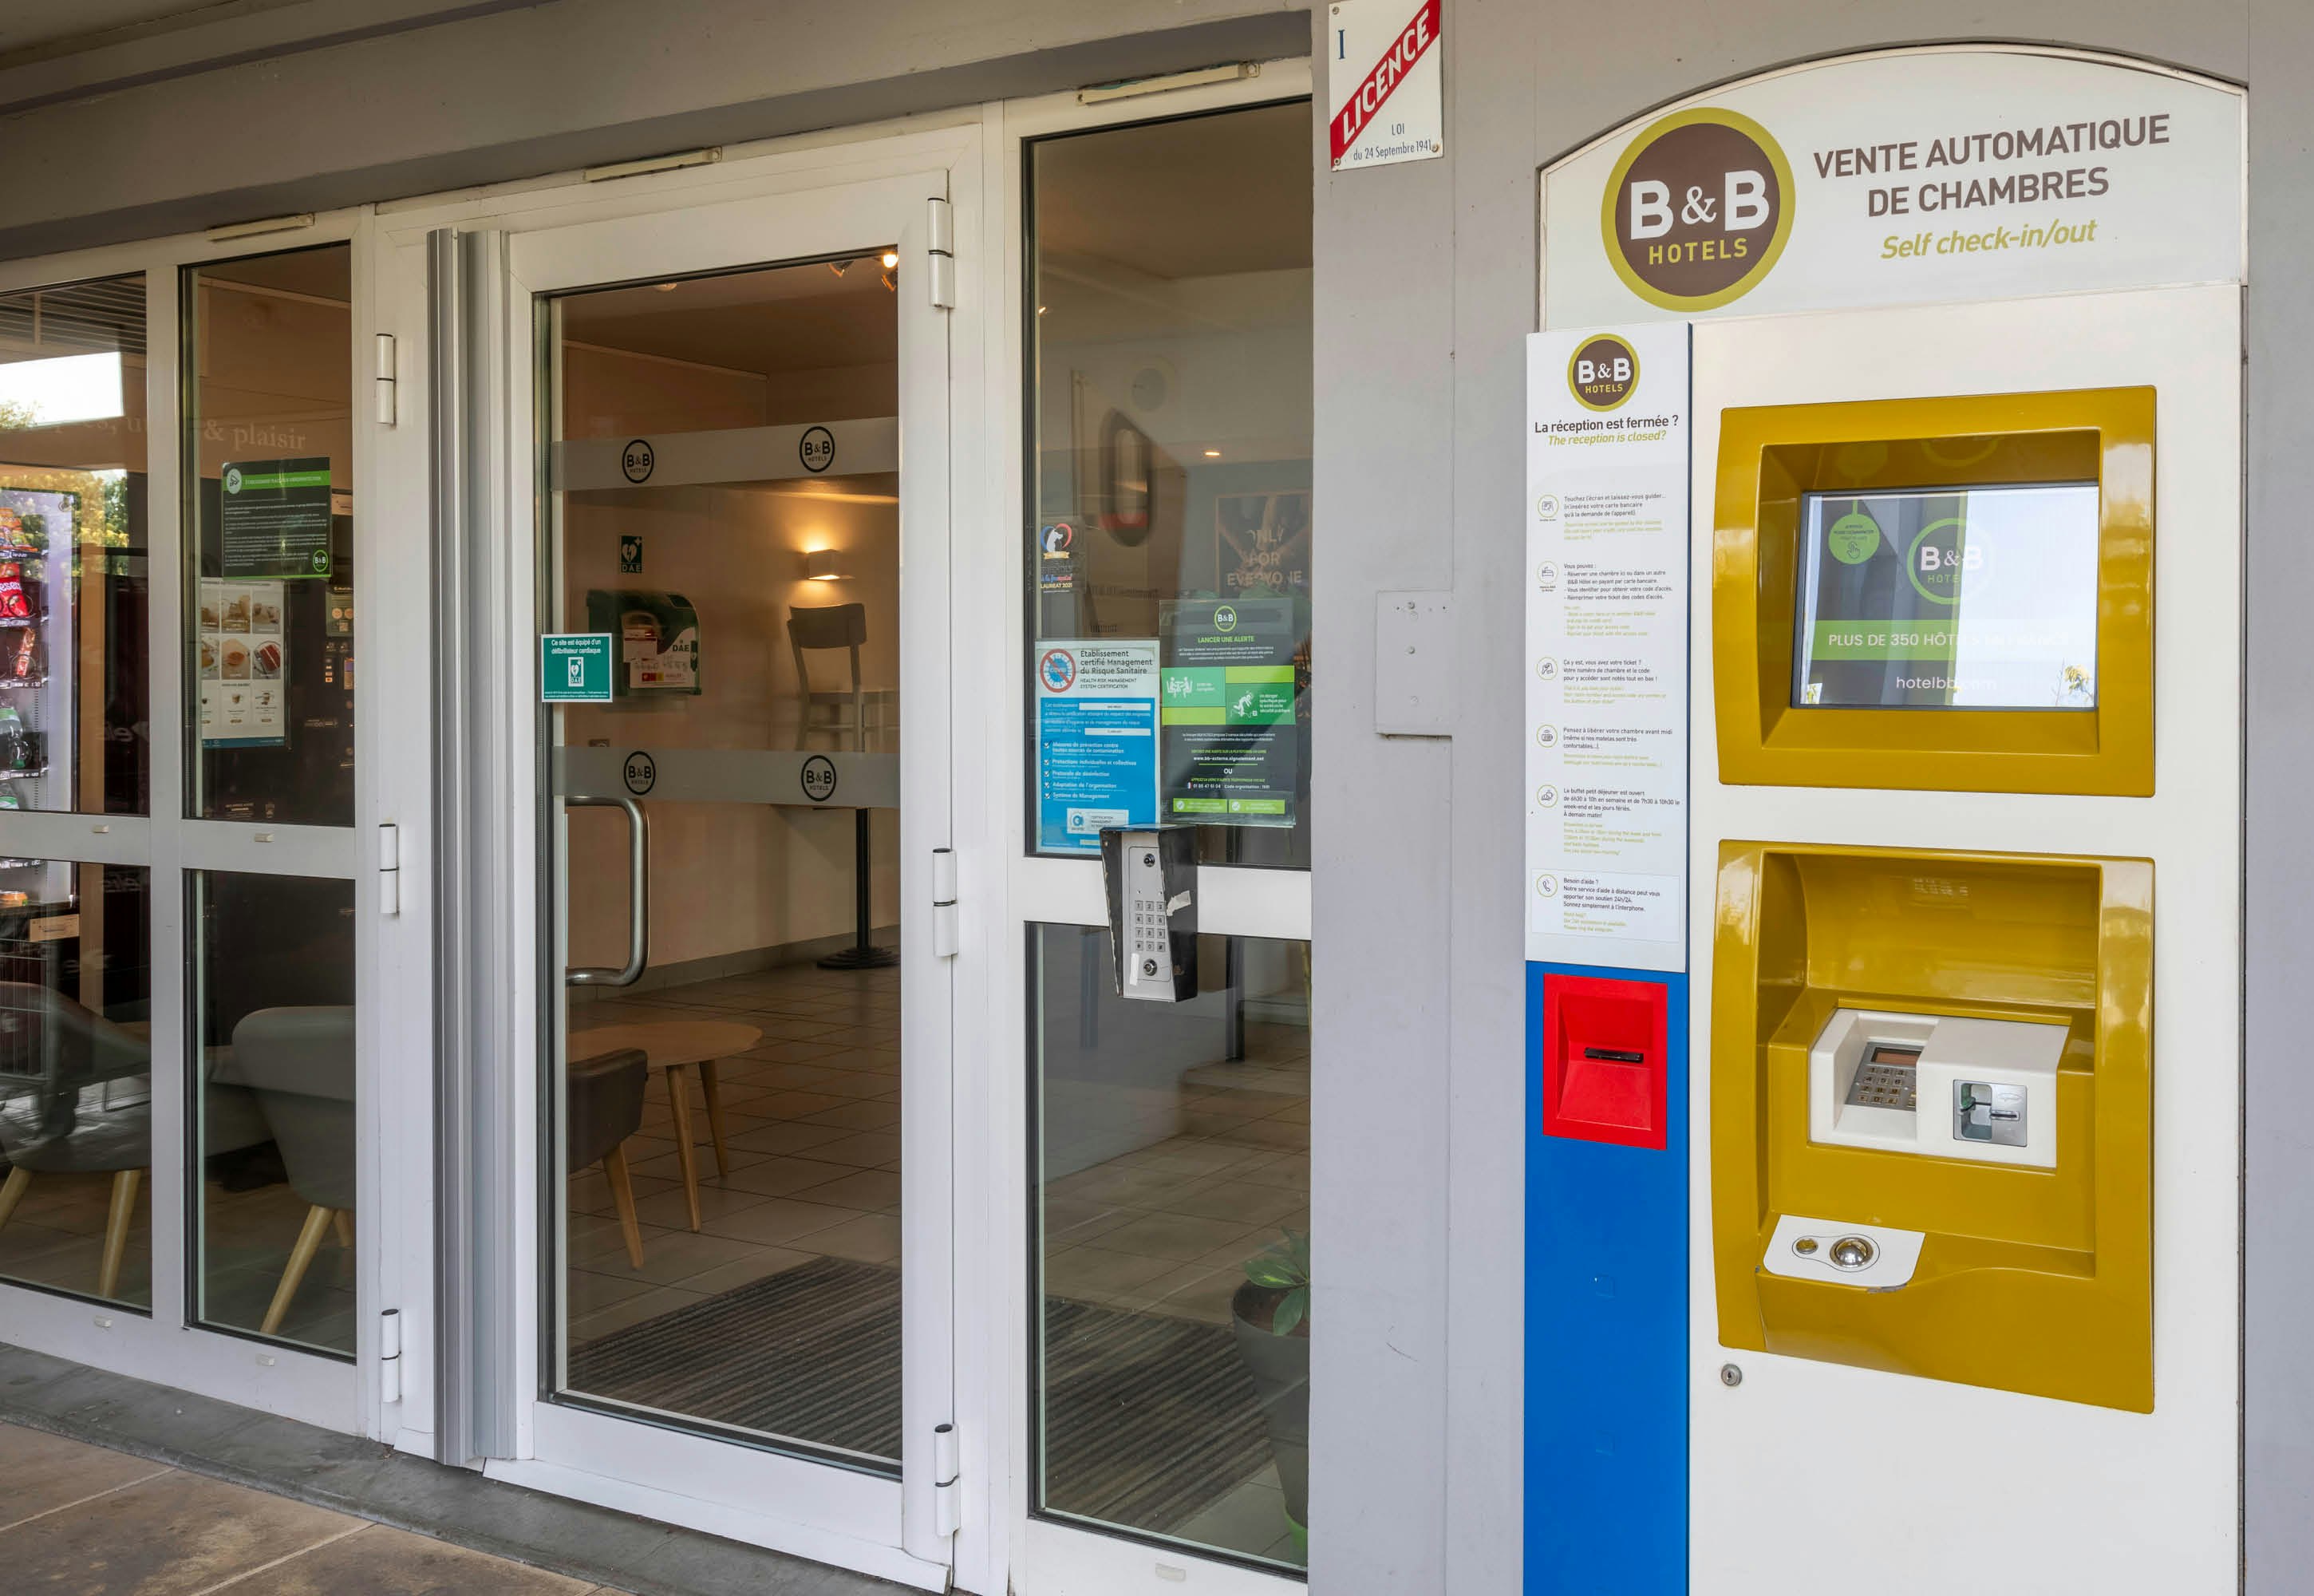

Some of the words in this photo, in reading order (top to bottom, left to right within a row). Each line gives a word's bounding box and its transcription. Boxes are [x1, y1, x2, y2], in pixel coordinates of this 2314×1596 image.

[1338, 30, 1345, 60] I
[1343, 9, 1429, 144] LICENCE
[1392, 123, 1404, 135] LOI
[1353, 149, 1361, 160] du
[1364, 148, 1373, 158] 24
[1376, 143, 1415, 160] Septembre
[1416, 139, 1431, 152] 1941
[1814, 141, 1917, 179] VENTE
[1925, 113, 2171, 168] AUTOMATIQUE
[1868, 185, 1910, 218] DE
[1917, 166, 2110, 211] CHAMBRES
[1630, 169, 1770, 239] B&B
[1879, 233, 1929, 259] Self
[1936, 218, 2098, 255] check-in/out
[1648, 238, 1748, 265] HOTELS
[1578, 358, 1631, 384] B&B
[1585, 383, 1623, 393] HOTELS
[1534, 422, 1548, 433] La
[1551, 419, 1603, 434] réception
[1606, 417, 1624, 429] est
[1626, 415, 1669, 429] fermée
[203, 419, 223, 440] &
[232, 423, 306, 451] plaisir
[1549, 435, 1566, 446] The
[1568, 433, 1614, 446] reception
[1617, 433, 1625, 443] is
[1627, 430, 1667, 441] closed?
[804, 440, 831, 456] B&B
[626, 453, 650, 468] B&B
[1217, 614, 1234, 622] B&B
[1828, 634, 1863, 646] PLUS
[1868, 634, 1886, 646] DE
[1890, 634, 1919, 646] 350
[629, 766, 651, 779] B&B
[806, 770, 832, 784] B&B
